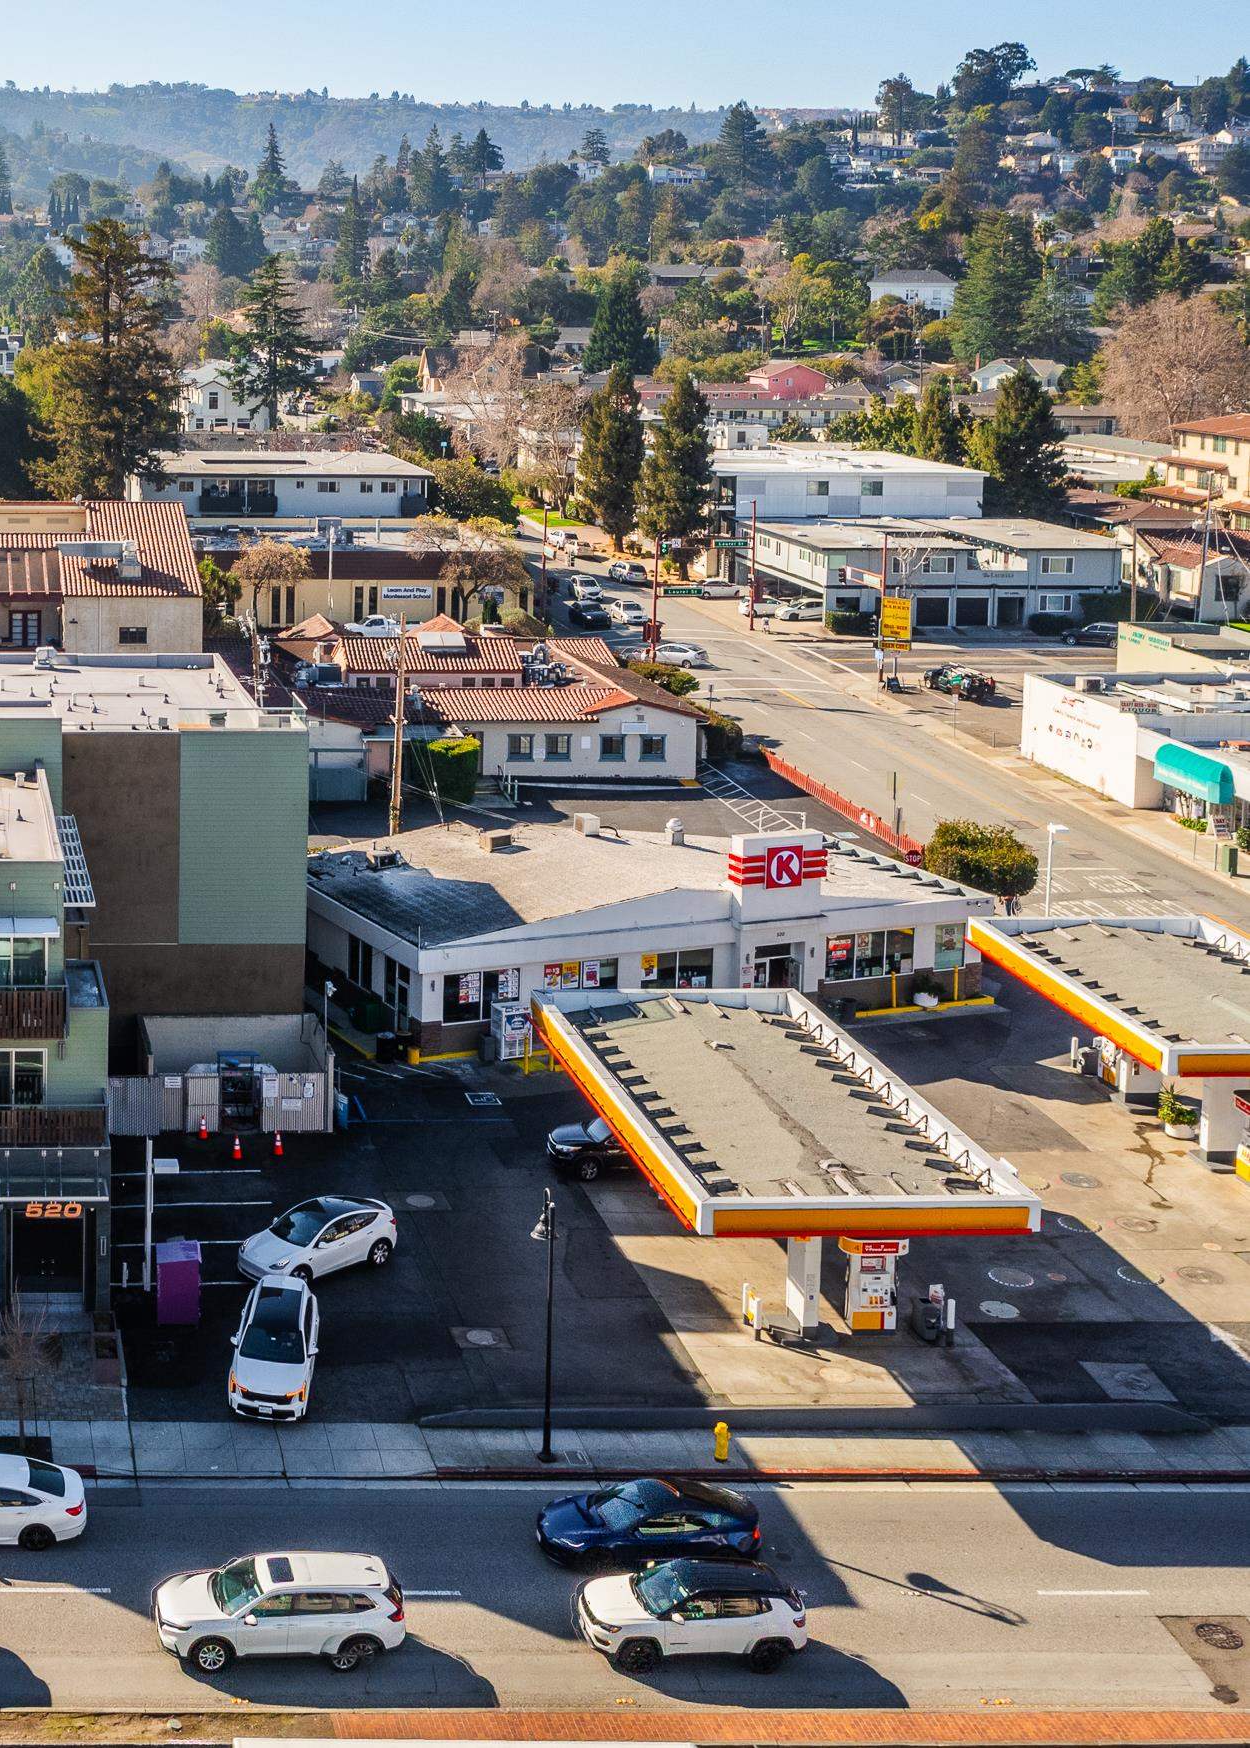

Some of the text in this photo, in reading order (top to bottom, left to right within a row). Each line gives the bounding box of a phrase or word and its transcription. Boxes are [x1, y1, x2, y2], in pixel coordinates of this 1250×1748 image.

[904, 854, 922, 862] STOP
[776, 853, 798, 882] K
[25, 1203, 82, 1218] 520
